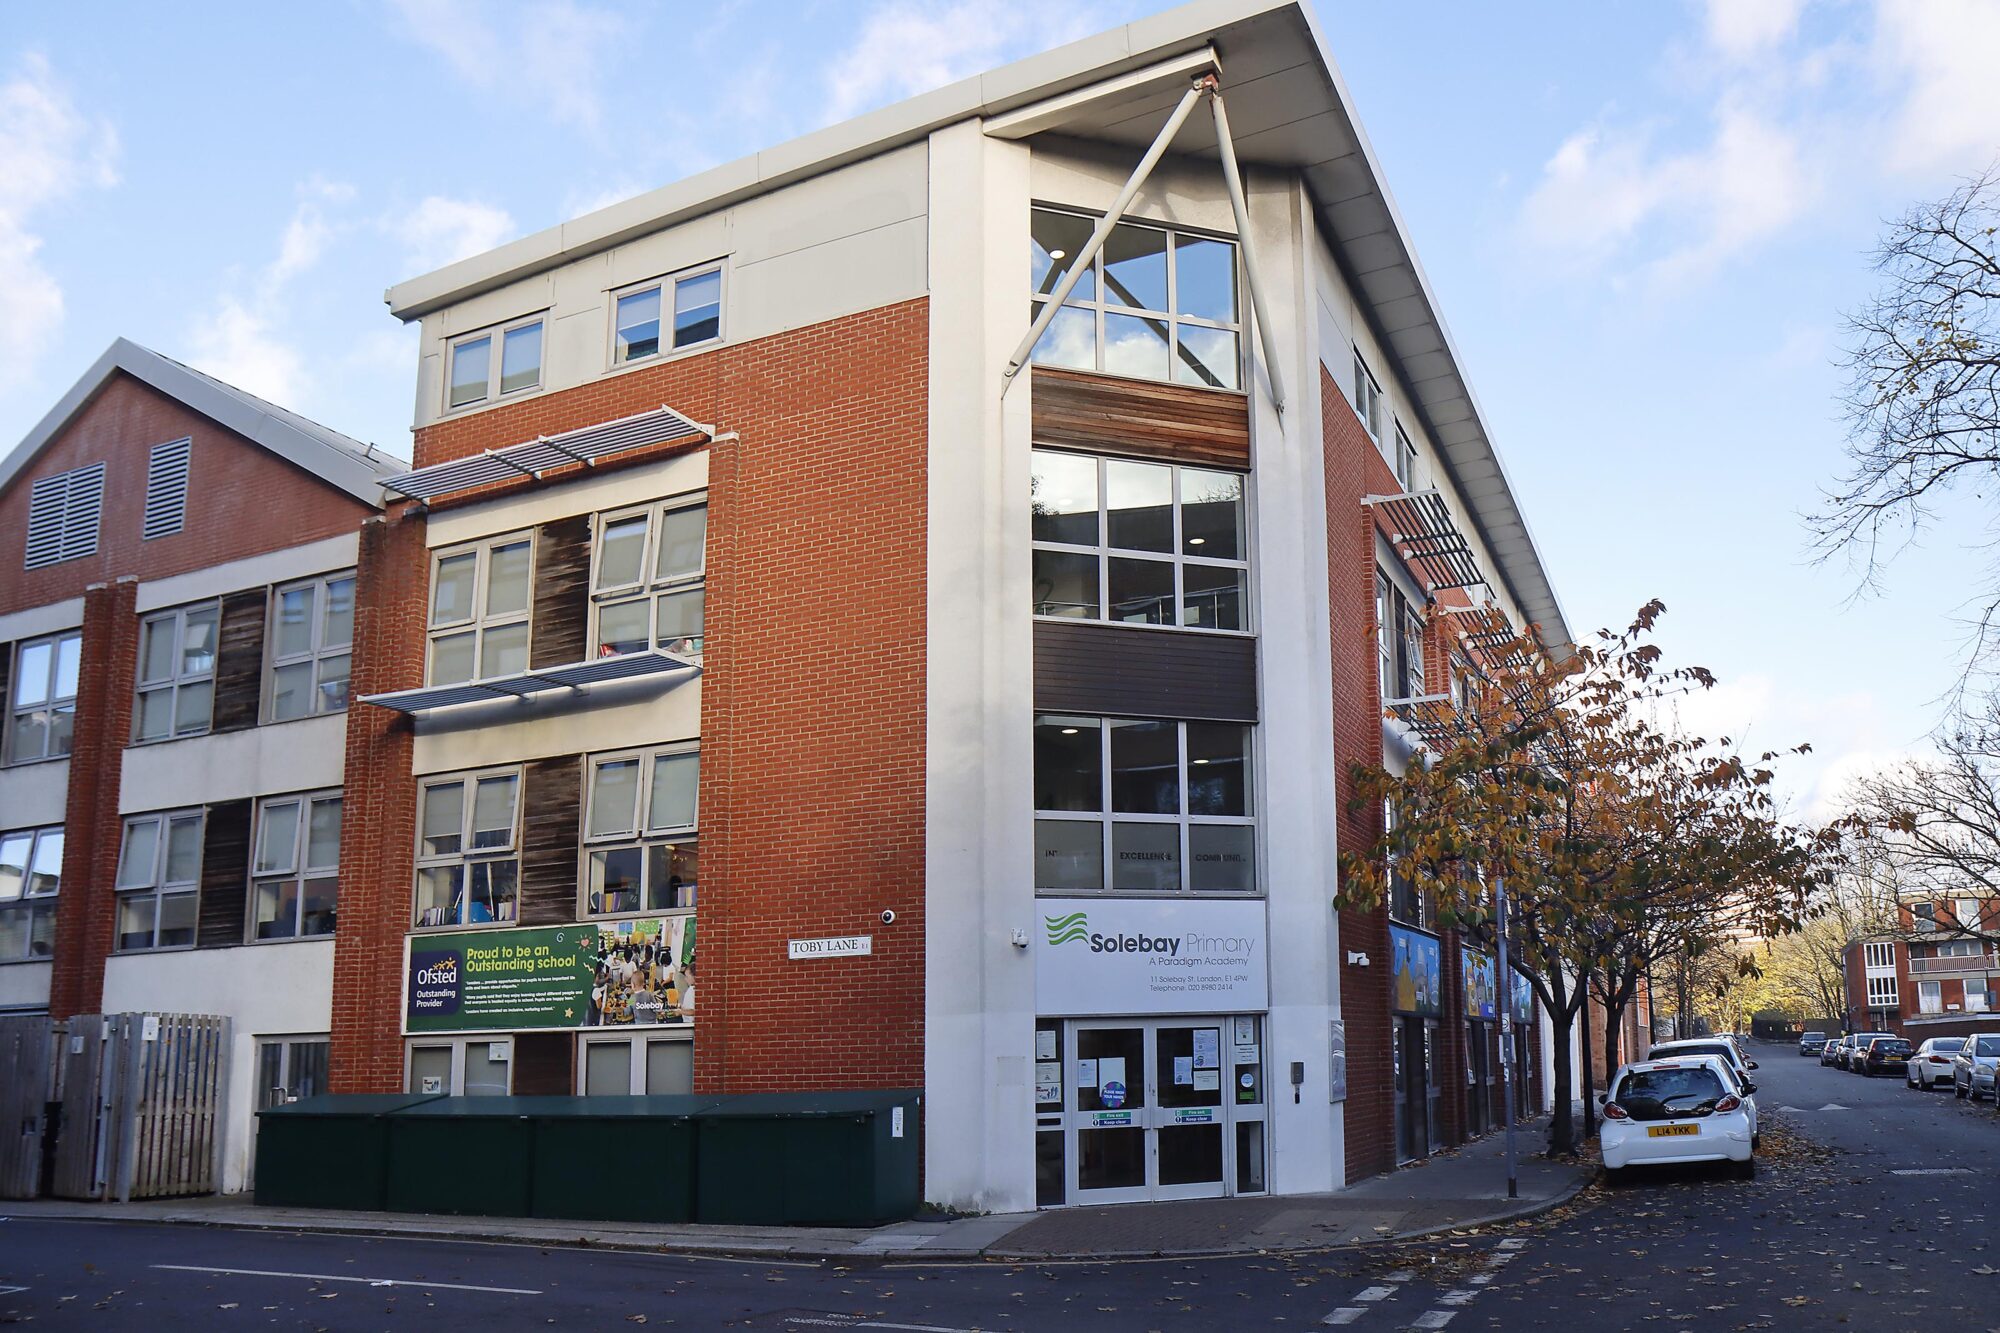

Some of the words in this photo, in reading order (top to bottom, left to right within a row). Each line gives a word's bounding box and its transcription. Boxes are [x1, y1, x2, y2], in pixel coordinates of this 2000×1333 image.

[792, 941, 823, 953] TOBY
[827, 939, 858, 951] LANE
[1090, 933, 1180, 956] Solebay
[1186, 933, 1255, 956] Primary
[467, 946, 499, 960] Proud
[502, 946, 513, 958] to
[516, 945, 531, 957] be
[534, 945, 549, 956] an
[466, 958, 535, 972] Outstanding
[537, 954, 576, 969] school
[1149, 957, 1156, 965] A
[1158, 957, 1202, 967] Paradigm
[1204, 957, 1248, 966] Academy
[417, 967, 457, 985] Ofsted
[1159, 975, 1186, 984] Solebay
[416, 989, 456, 999] Outstanding
[416, 999, 443, 1008] Provider
[635, 1002, 664, 1010] Solebay
[1672, 1126, 1690, 1135] YKK
